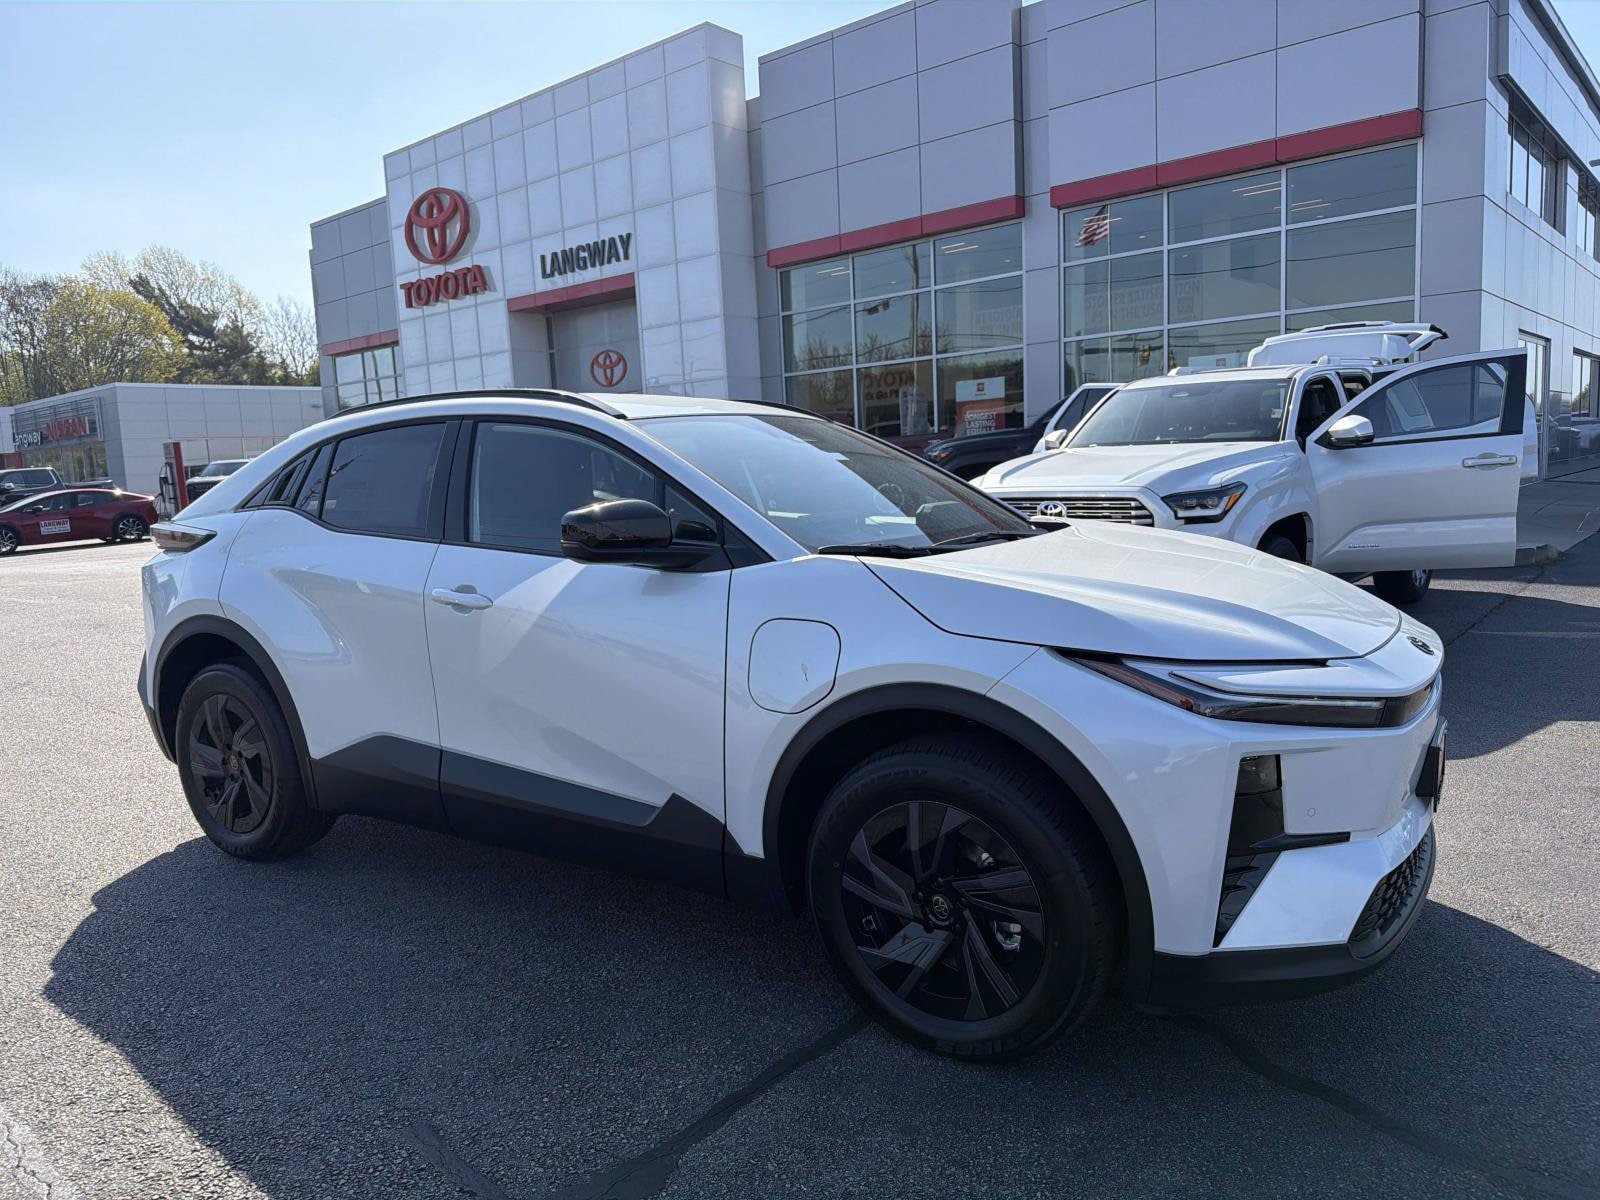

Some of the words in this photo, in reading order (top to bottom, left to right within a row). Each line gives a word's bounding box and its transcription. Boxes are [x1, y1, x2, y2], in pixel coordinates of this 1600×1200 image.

[540, 233, 632, 279] LANGWAY
[400, 264, 488, 308] TOYOTA
[12, 431, 41, 447] Langway
[46, 416, 90, 440] NISSAN
[965, 419, 996, 429] LASTING
[41, 519, 69, 528] LANGWAY
